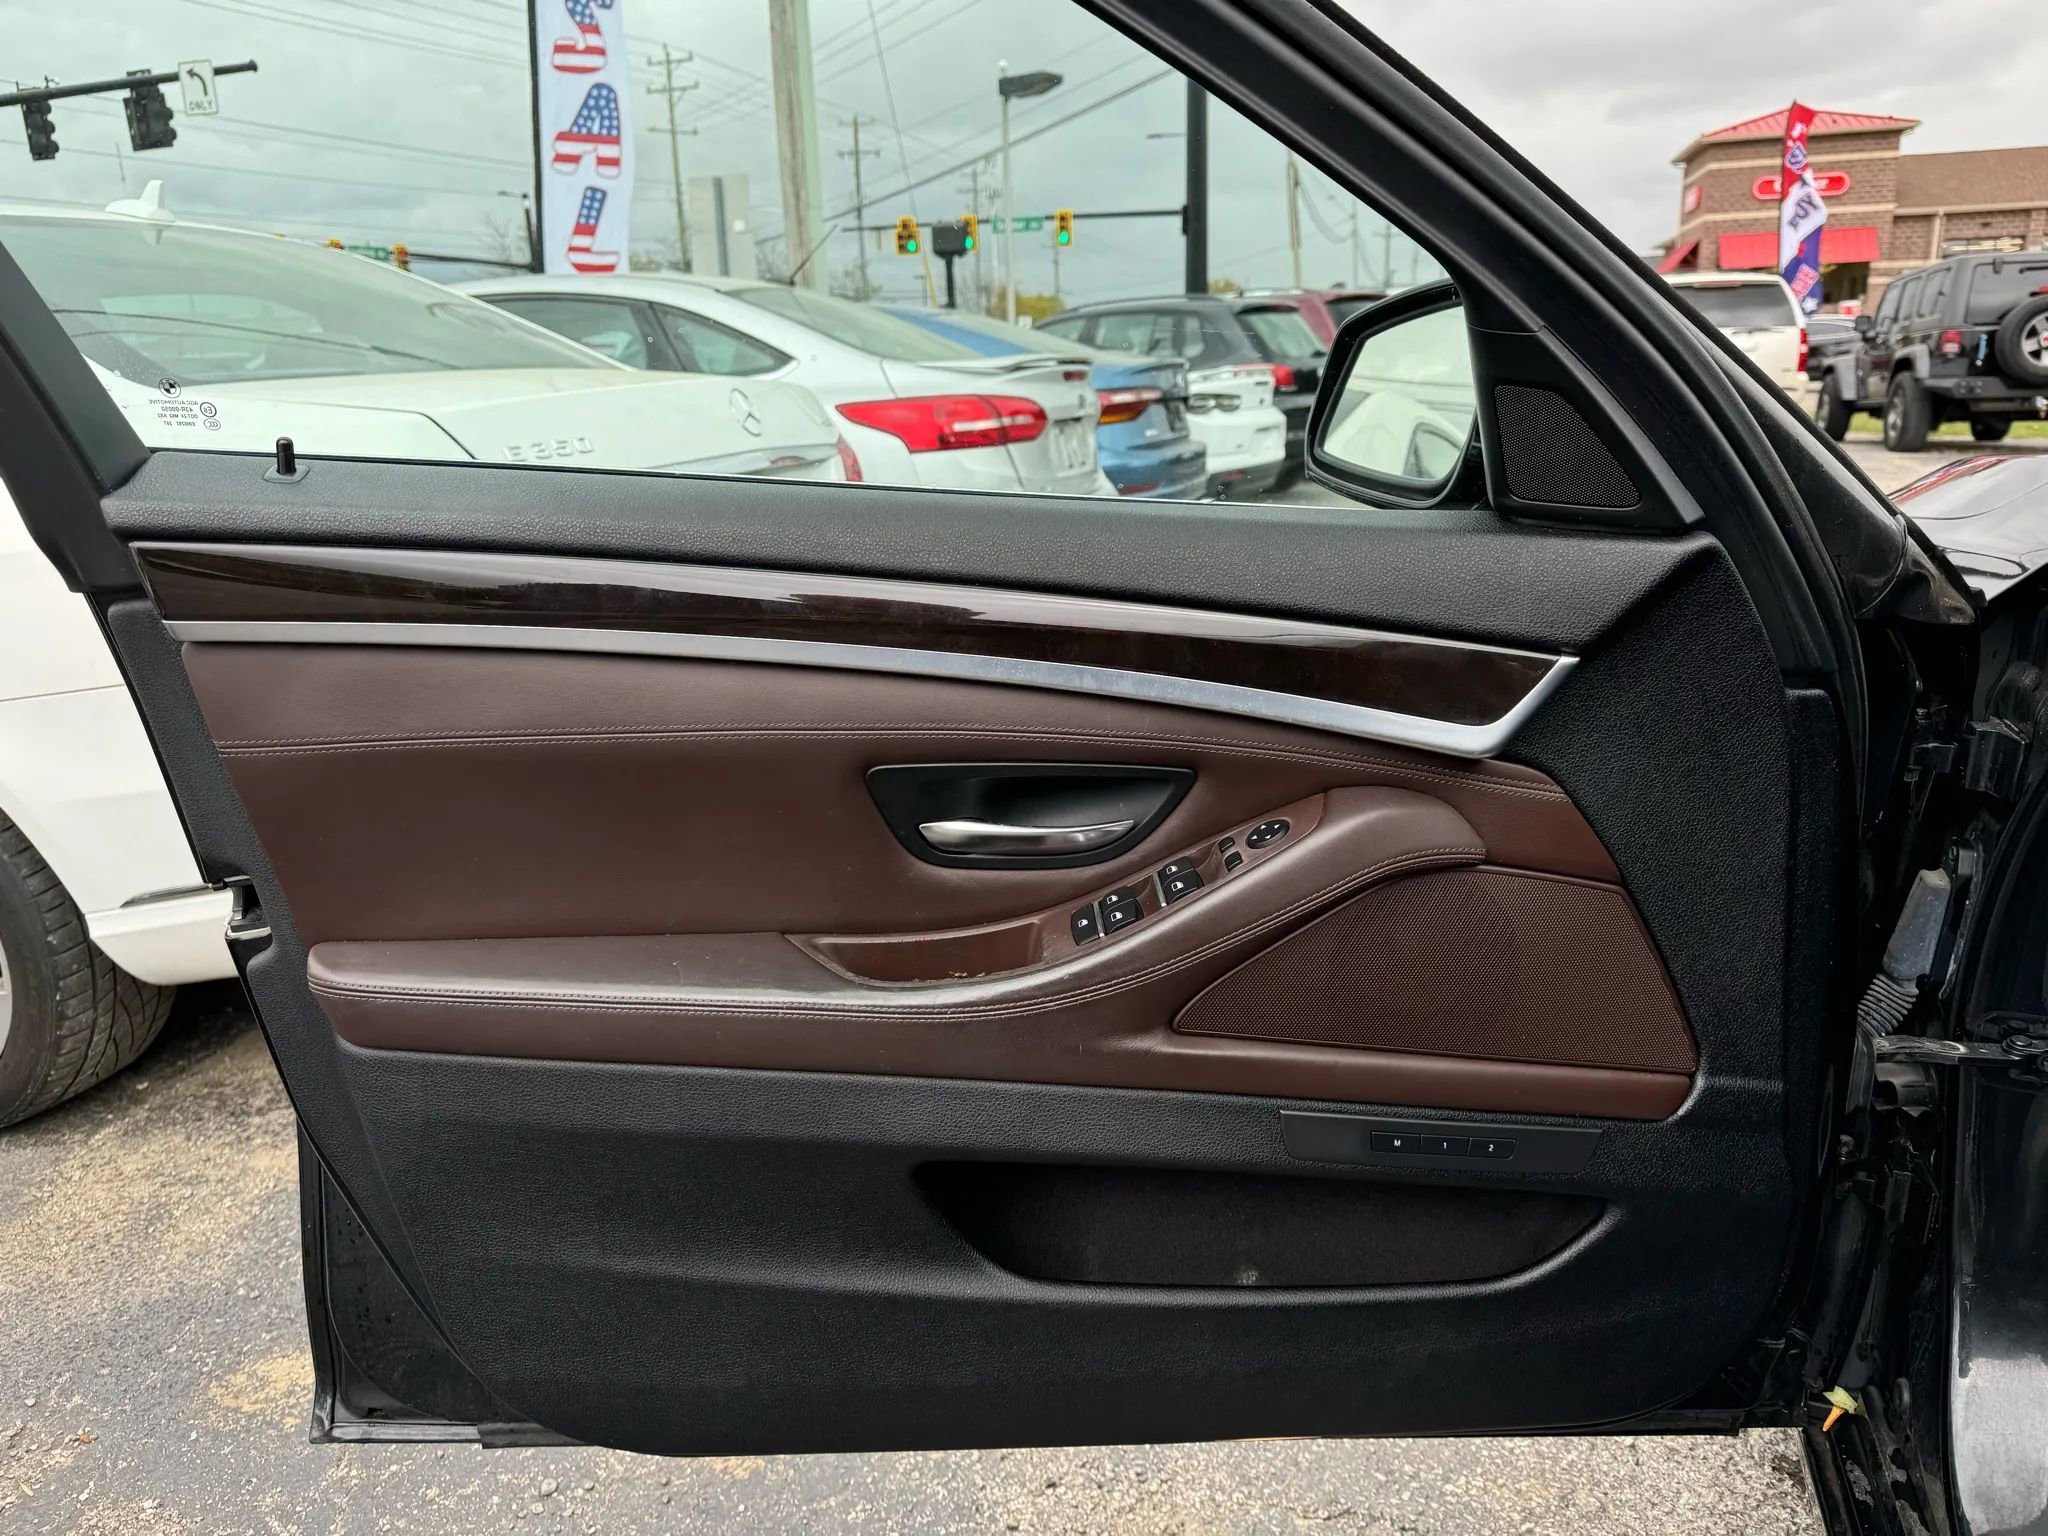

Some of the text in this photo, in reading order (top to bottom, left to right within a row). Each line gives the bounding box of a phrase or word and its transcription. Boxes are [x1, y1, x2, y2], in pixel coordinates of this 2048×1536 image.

[189, 100, 212, 111] ONLY
[1393, 1139, 1401, 1147] M
[1488, 1144, 1494, 1152] 2
